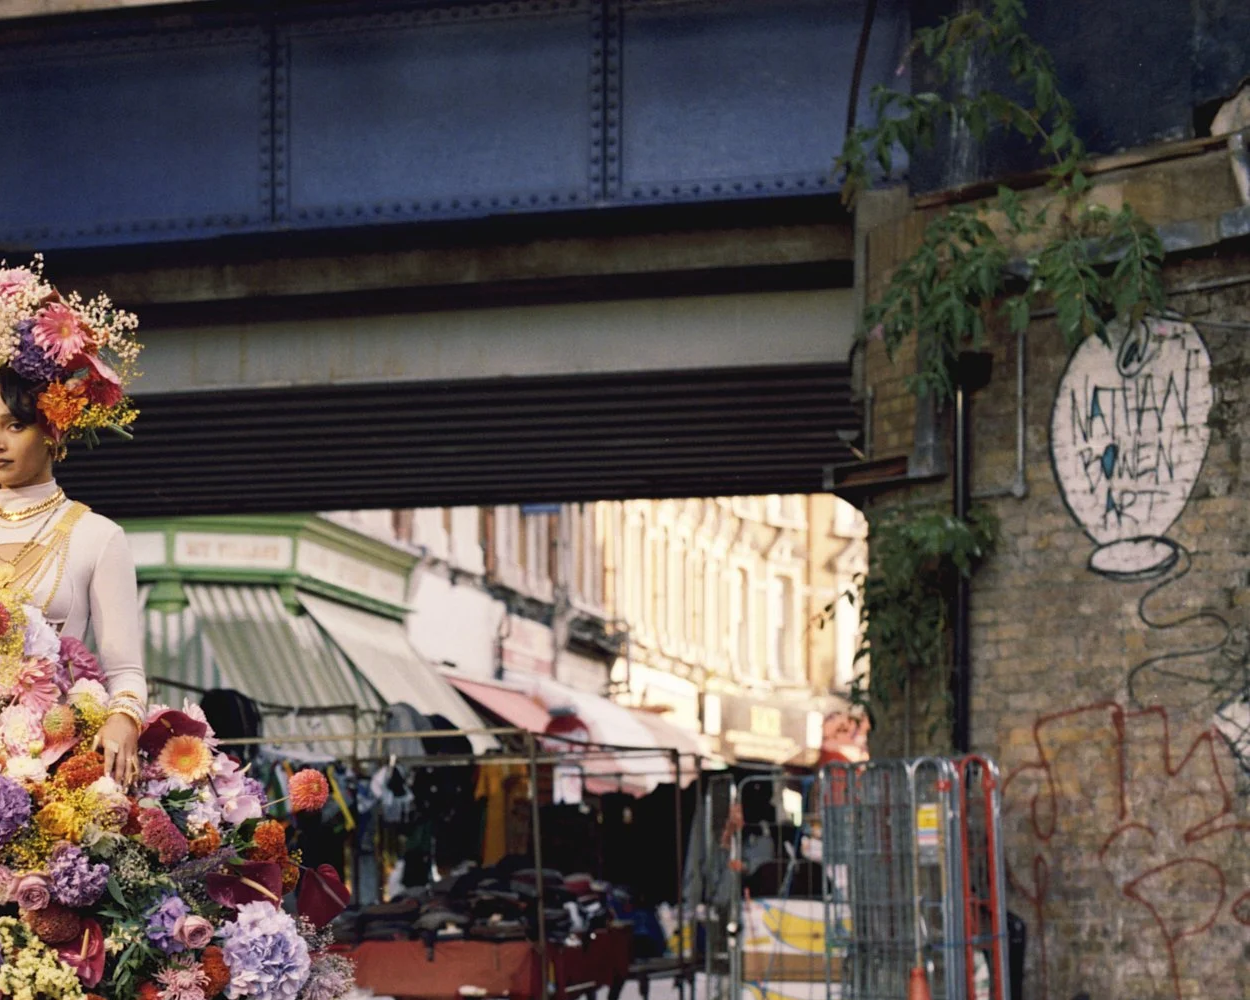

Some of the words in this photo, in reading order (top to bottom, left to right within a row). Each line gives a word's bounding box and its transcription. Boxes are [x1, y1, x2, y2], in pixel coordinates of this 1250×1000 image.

[1070, 349, 1196, 446] NATHAN
[1077, 433, 1175, 494] BOWEN
[1102, 484, 1171, 530] ART
